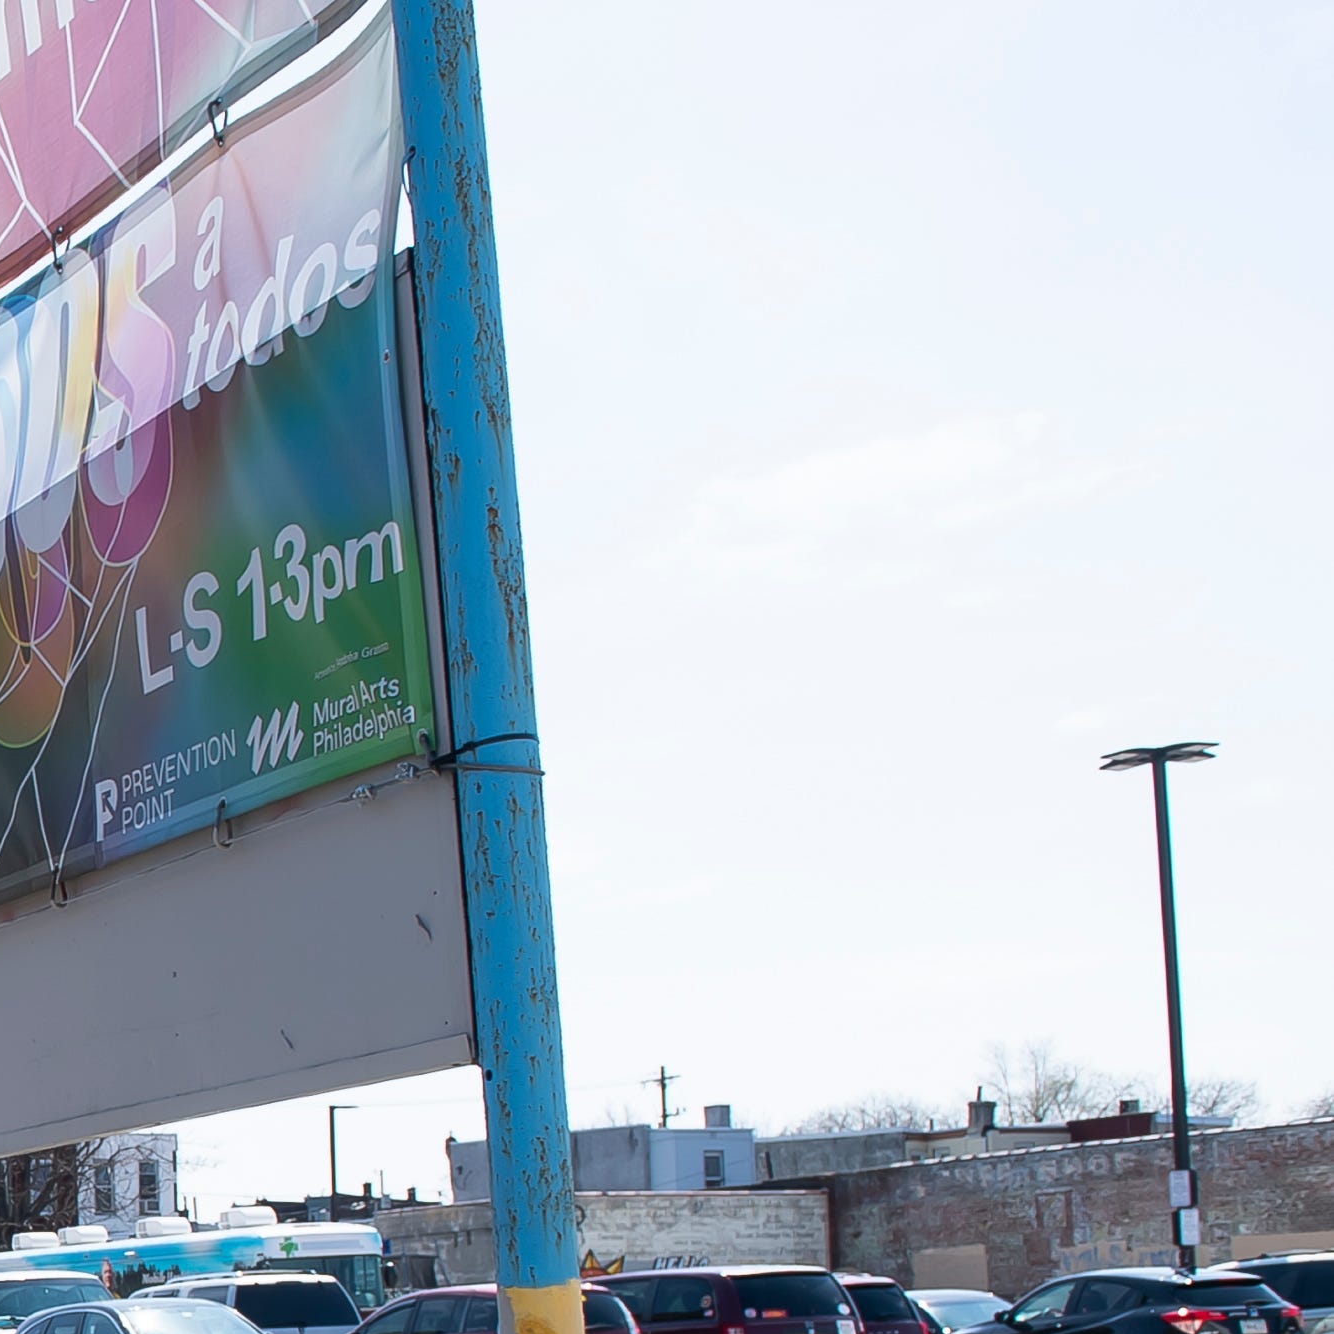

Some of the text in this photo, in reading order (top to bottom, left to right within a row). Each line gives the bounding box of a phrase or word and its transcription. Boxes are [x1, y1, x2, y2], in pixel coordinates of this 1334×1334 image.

[194, 196, 224, 290] a
[183, 209, 382, 411] todos
[121, 728, 236, 802] PREVENTION
[312, 700, 416, 757] Philadelphia
[121, 787, 175, 835] POINT
